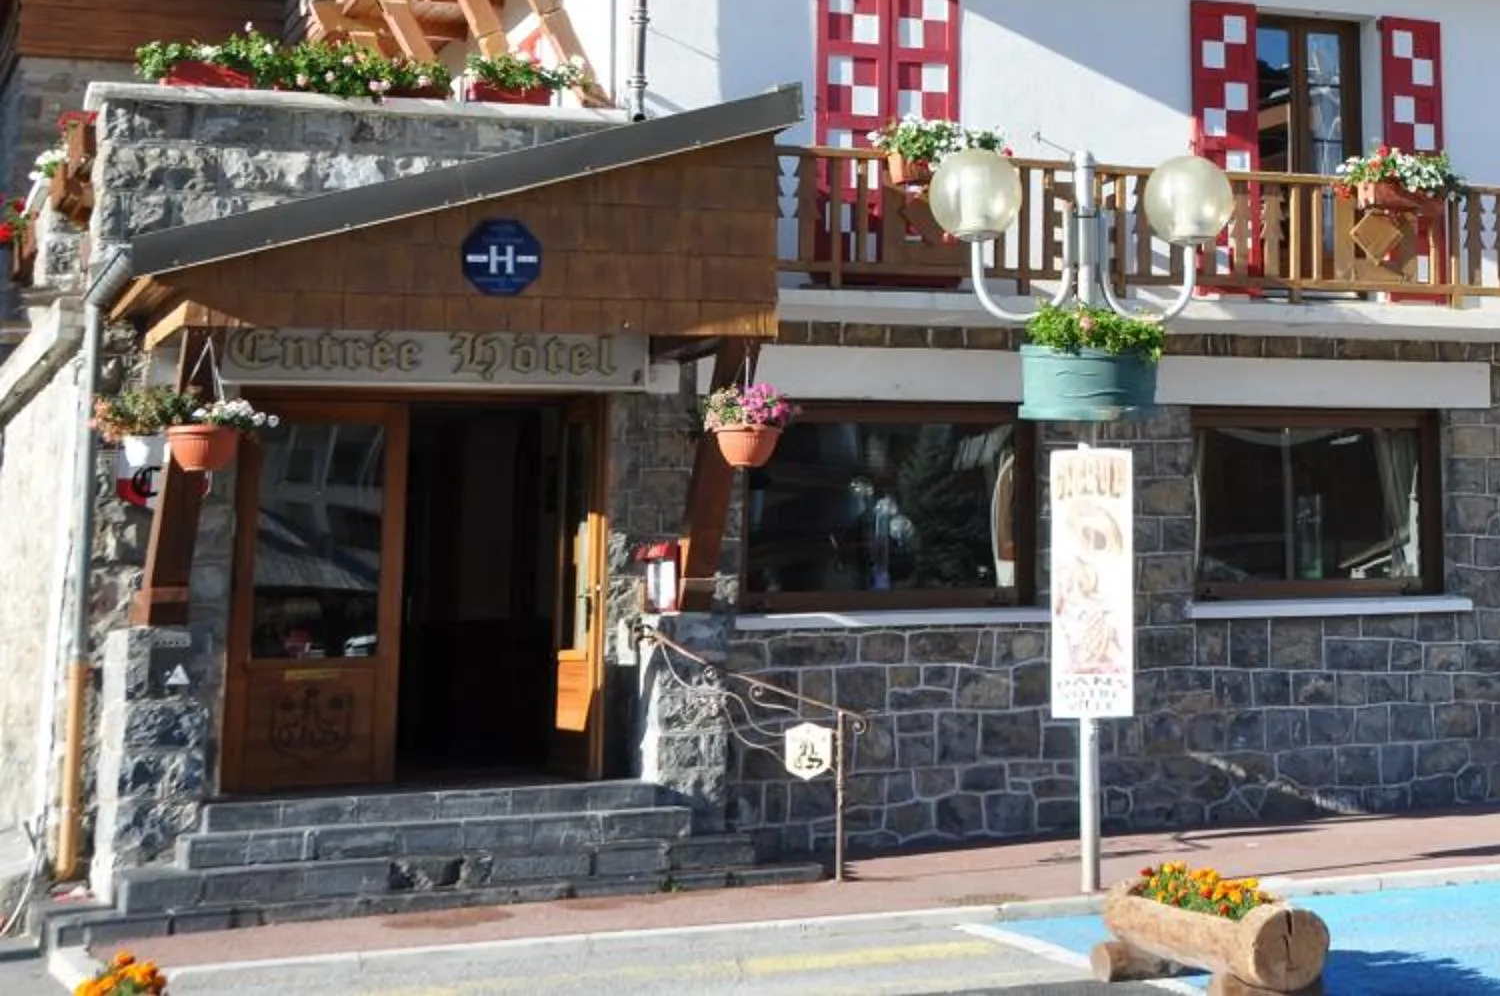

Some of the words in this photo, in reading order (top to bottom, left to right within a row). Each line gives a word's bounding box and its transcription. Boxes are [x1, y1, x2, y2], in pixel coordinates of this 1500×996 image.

[489, 244, 515, 275] H
[229, 326, 423, 373] Entrée
[449, 331, 618, 382] Hôtel
